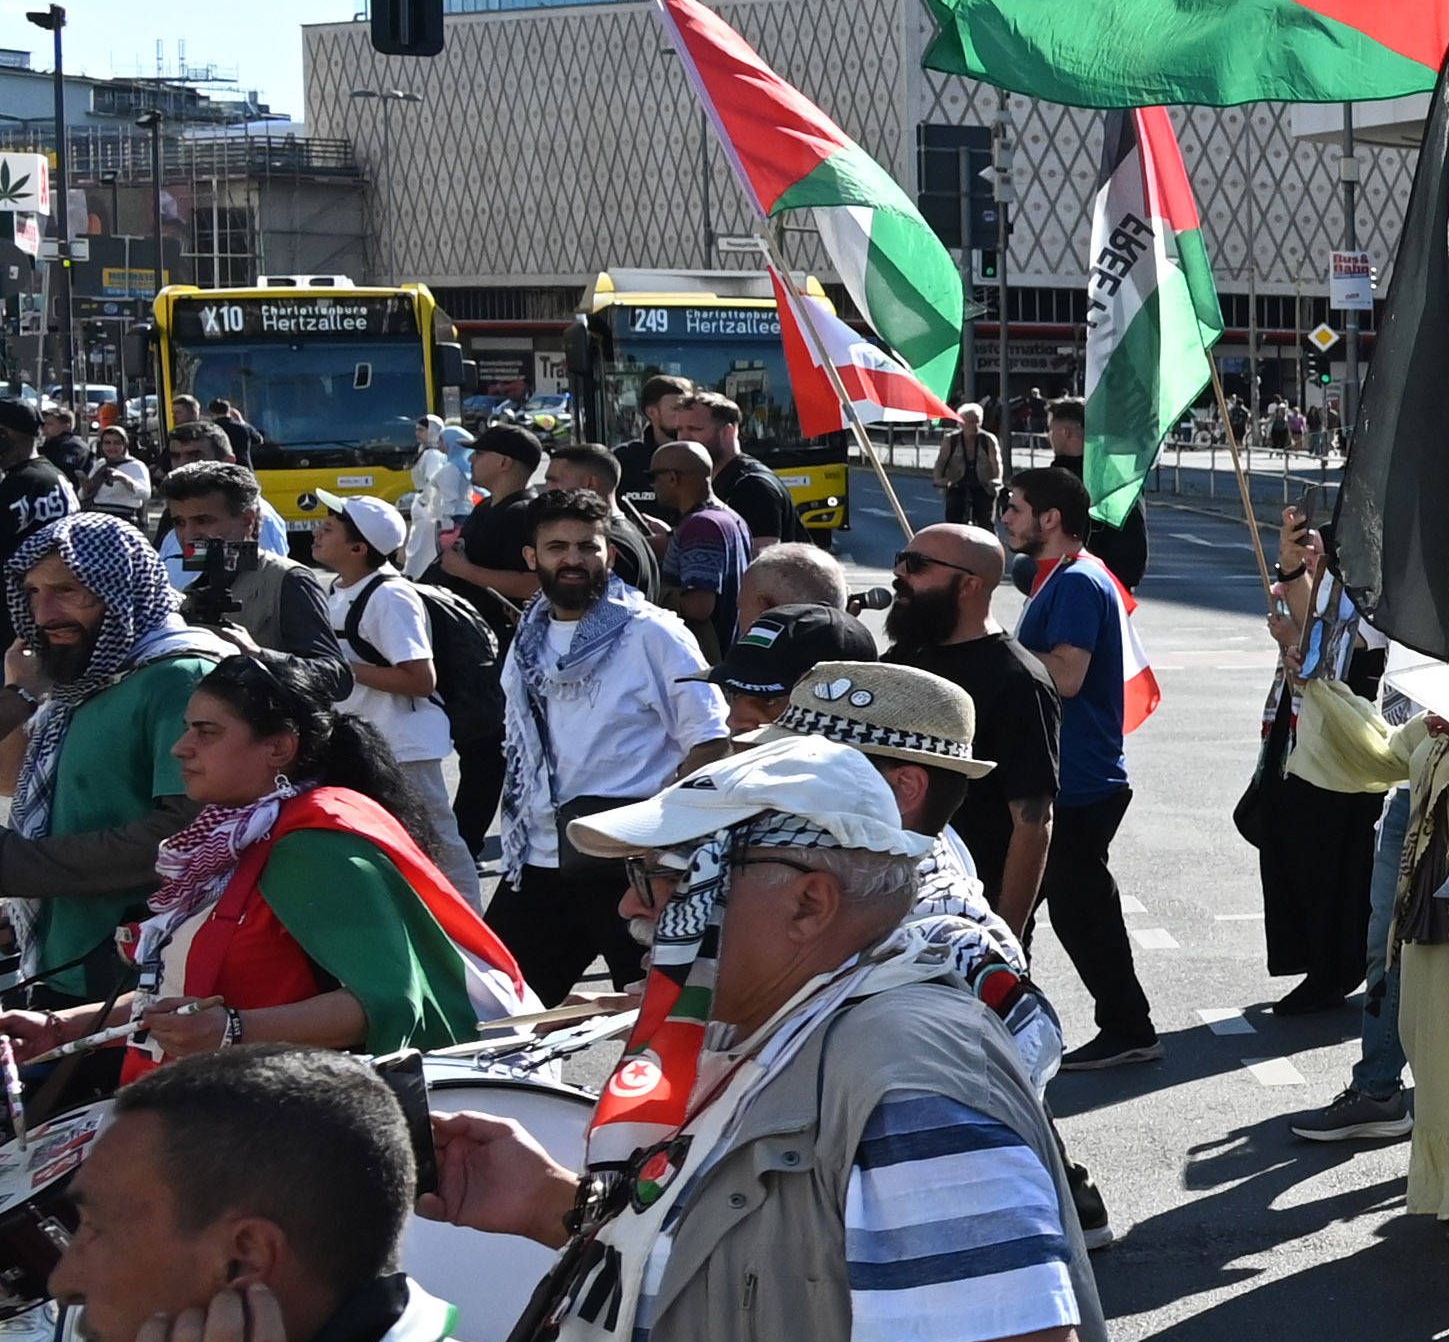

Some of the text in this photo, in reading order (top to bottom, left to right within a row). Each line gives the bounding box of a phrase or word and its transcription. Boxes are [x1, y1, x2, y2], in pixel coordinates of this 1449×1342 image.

[204, 306, 243, 332] X10
[263, 315, 367, 332] Hertzallee
[635, 309, 668, 333] 249
[686, 319, 781, 334] Hertzallee
